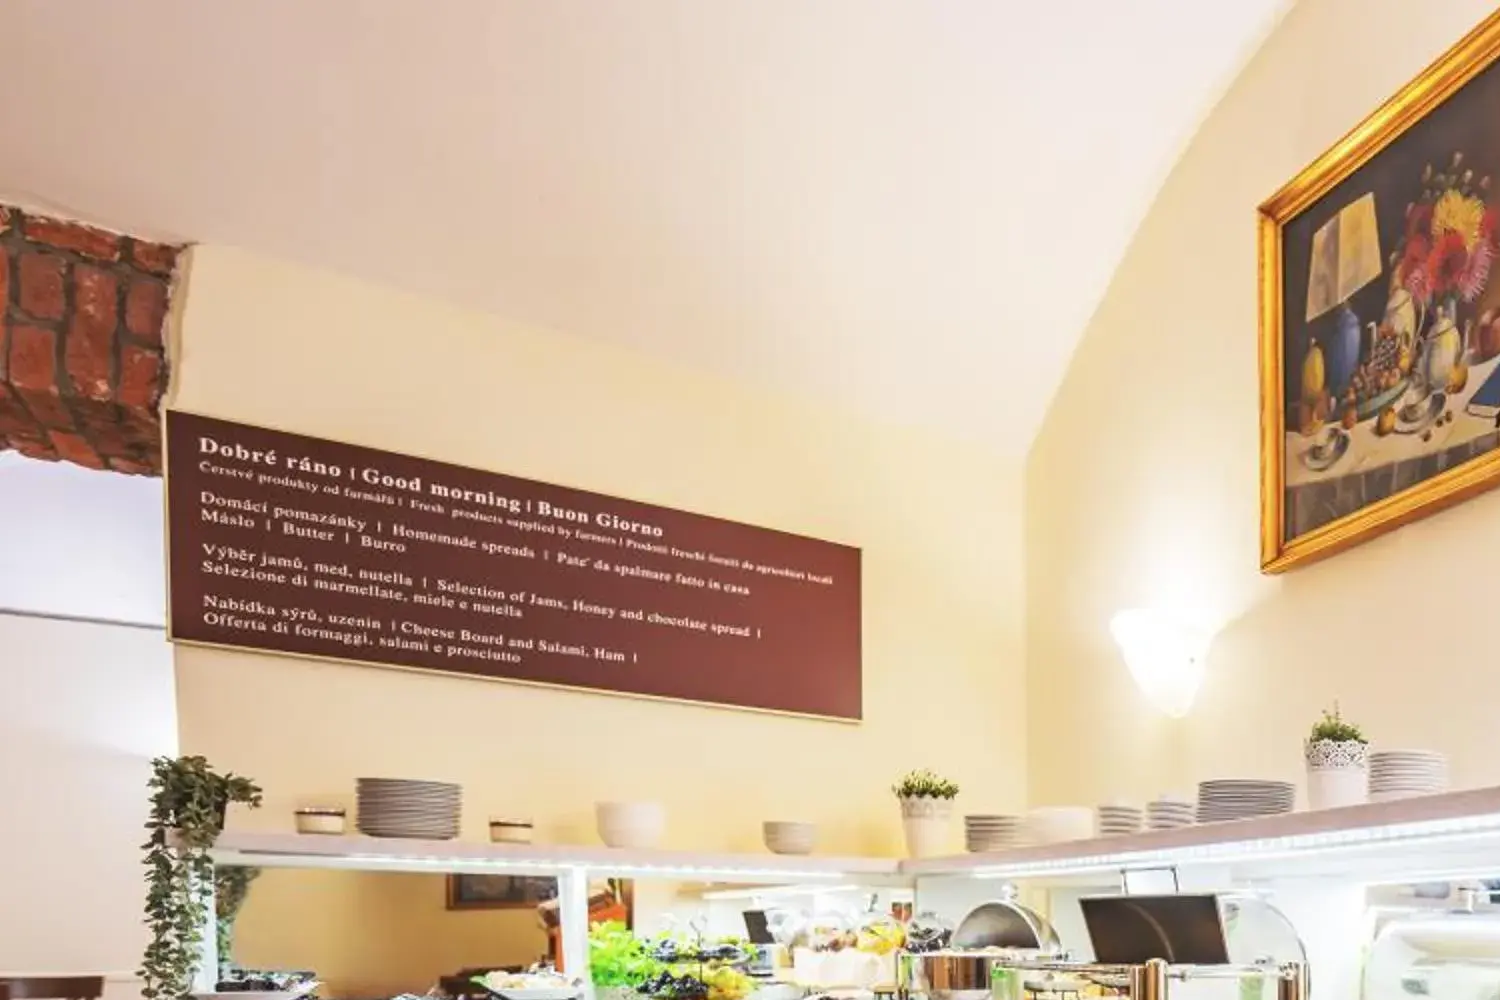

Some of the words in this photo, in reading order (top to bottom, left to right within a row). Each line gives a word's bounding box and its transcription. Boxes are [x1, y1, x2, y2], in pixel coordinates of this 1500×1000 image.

[200, 437, 277, 465] Dobré
[287, 456, 341, 477] ráno
[362, 468, 421, 492] Good
[431, 482, 521, 513] morning
[538, 501, 588, 524] Buon
[596, 513, 663, 537] Giorno
[258, 472, 318, 494] produkty
[323, 483, 339, 496] od
[410, 498, 445, 514] Fresh
[451, 507, 503, 526] products
[506, 517, 555, 536] supplied
[558, 525, 572, 540] by
[201, 508, 256, 528] Máslo
[283, 521, 334, 542] Butter
[361, 534, 406, 553] Burro
[201, 491, 268, 514] Domácí
[273, 506, 366, 533] pomazánky
[393, 523, 477, 549] Homemade
[481, 540, 536, 559] spreads
[594, 558, 611, 572] da
[614, 561, 672, 583] spalmare
[675, 572, 705, 589] fatto
[709, 579, 721, 592] in
[724, 584, 750, 596] casa
[202, 560, 286, 584] Selezione
[292, 575, 308, 588] di
[313, 578, 408, 603] marmellate,
[413, 593, 454, 610] miele
[459, 601, 467, 610] e
[473, 602, 523, 619] nutella
[202, 543, 256, 563] Výběr
[314, 560, 353, 578] med,
[360, 569, 413, 587] nutella
[437, 579, 505, 600] Selection
[509, 590, 526, 604] of
[530, 593, 568, 612] Jams,
[572, 600, 616, 619] Honey
[620, 609, 644, 622] and
[647, 611, 707, 632] chocolate
[711, 622, 751, 640] spread
[203, 595, 276, 616] Nabídka
[401, 621, 455, 639] Cheese
[461, 629, 503, 646] Board
[508, 637, 533, 650] and
[538, 640, 590, 658] Salami,
[594, 647, 625, 662] Ham
[203, 611, 267, 632] Offerta
[272, 621, 288, 635] di
[295, 624, 373, 646] formaggi,
[379, 636, 429, 652] salami
[433, 643, 442, 653] e
[447, 644, 521, 664] prosciutto
